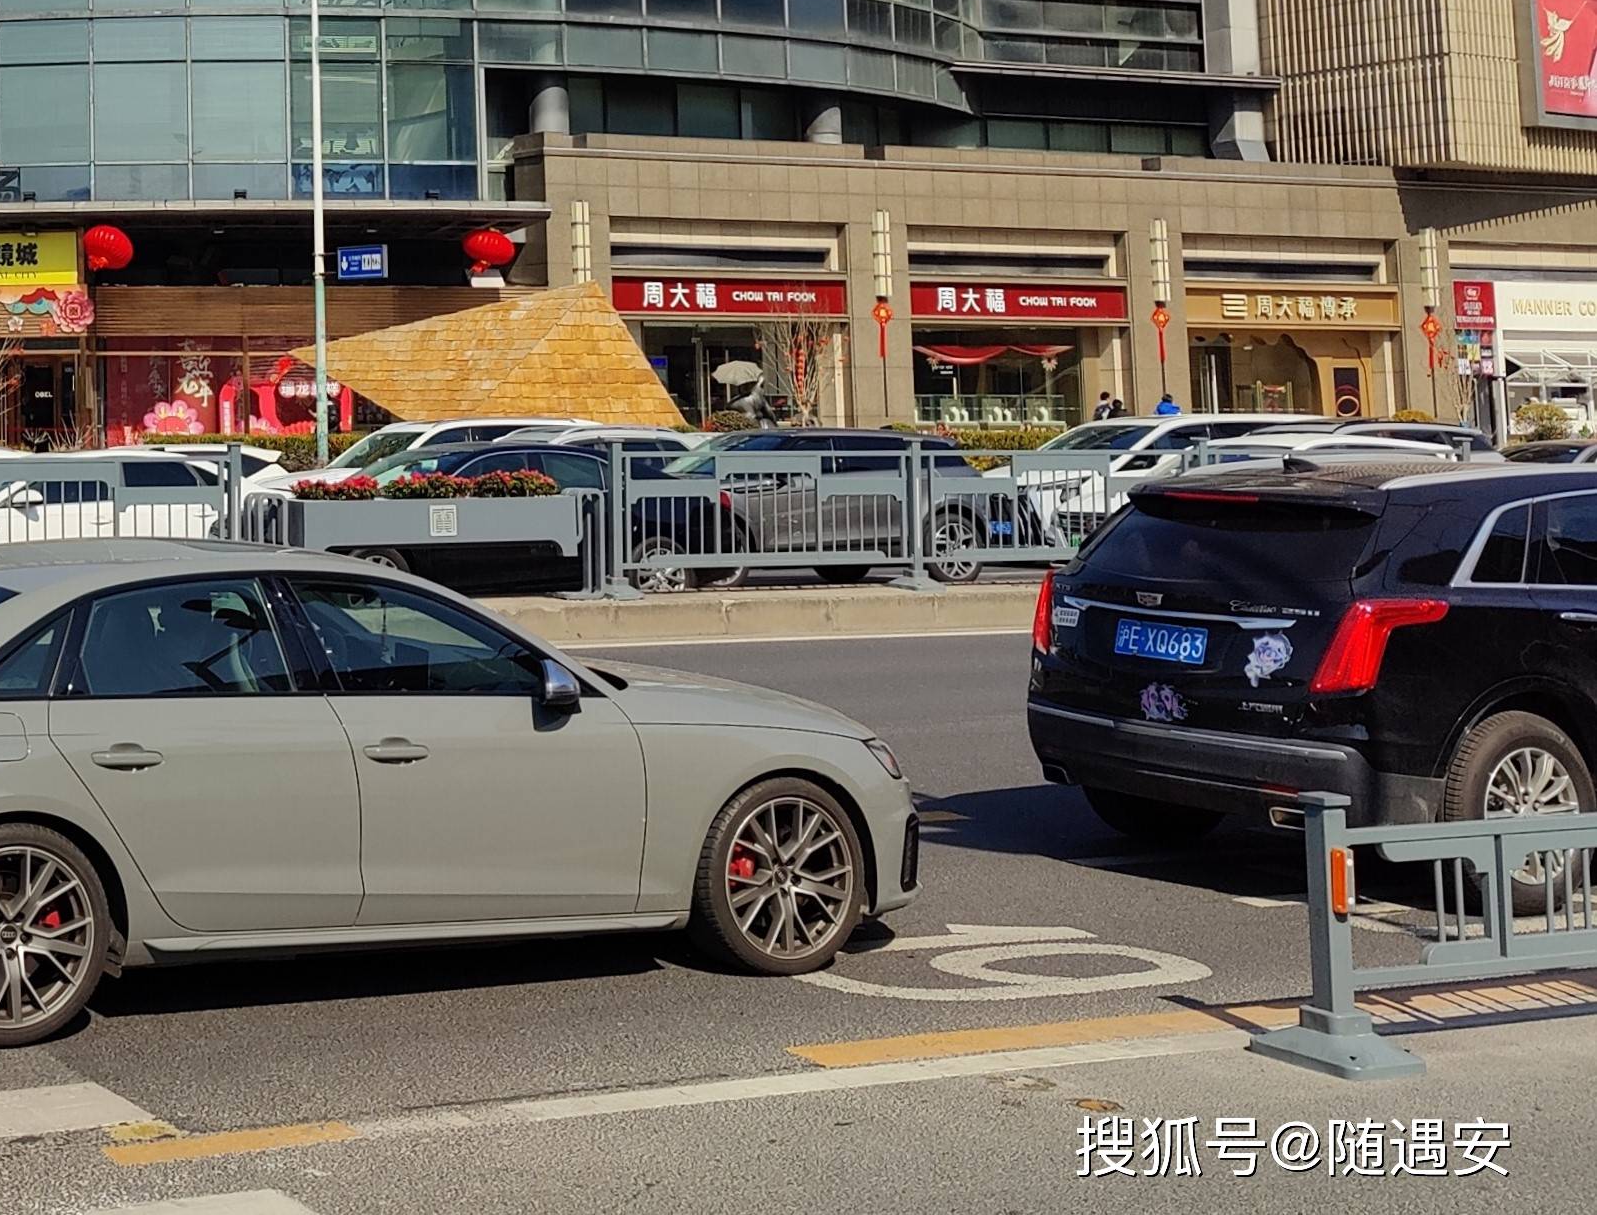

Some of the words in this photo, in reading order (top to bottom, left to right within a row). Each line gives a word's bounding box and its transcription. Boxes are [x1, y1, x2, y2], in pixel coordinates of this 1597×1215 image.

[643, 282, 717, 309] 周大福
[732, 291, 764, 302] CHOW
[767, 291, 784, 302] TAI
[787, 291, 817, 303] FOOK
[937, 287, 1006, 313] 周大福
[1019, 296, 1048, 307] CHOW
[1050, 296, 1067, 307] TAI
[1070, 297, 1097, 308] FOOK
[1512, 299, 1573, 317] MANNER
